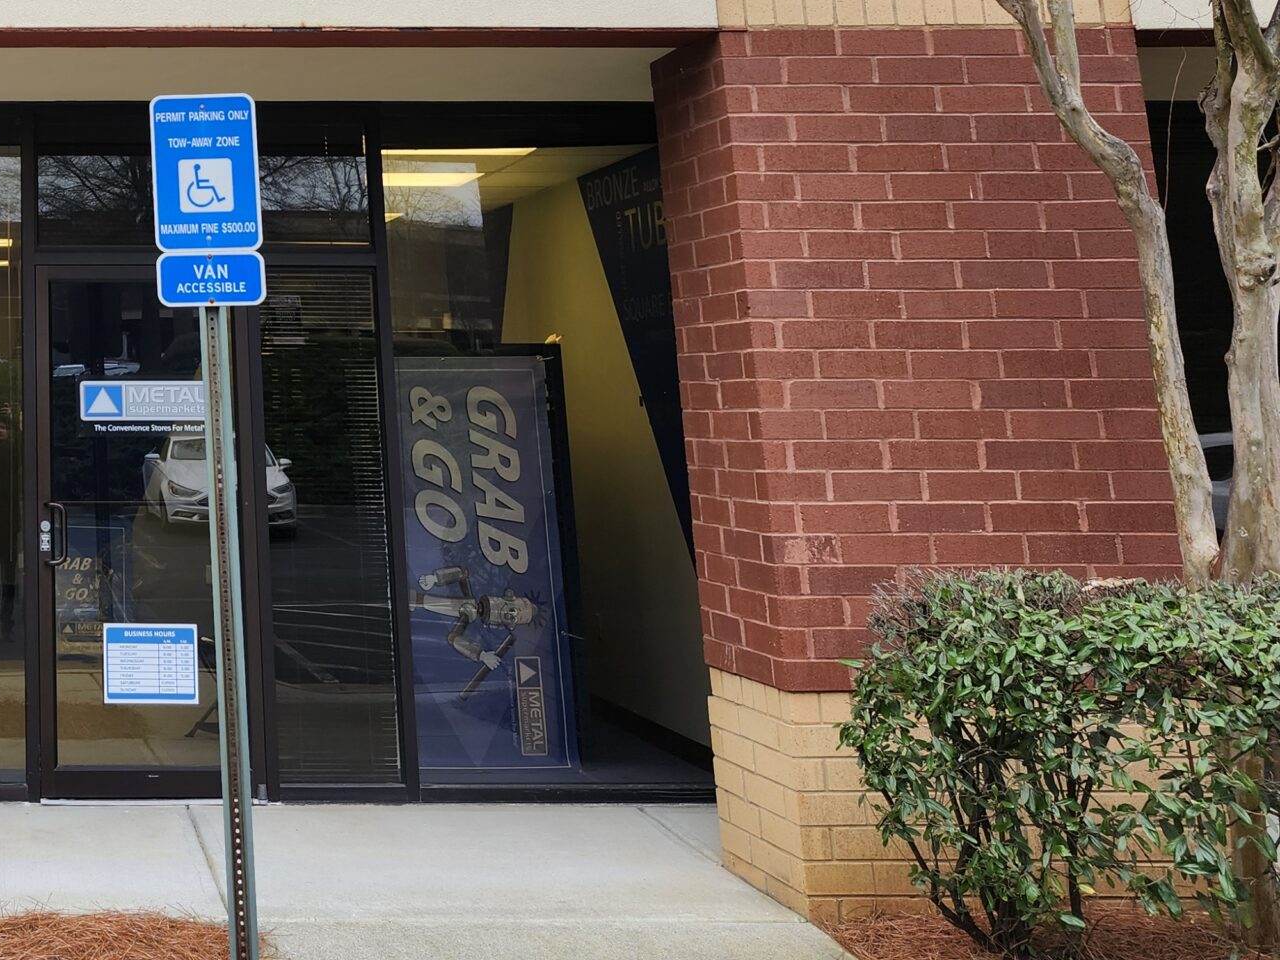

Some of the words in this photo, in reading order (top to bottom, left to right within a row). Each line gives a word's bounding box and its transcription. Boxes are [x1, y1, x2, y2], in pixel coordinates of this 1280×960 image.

[155, 111, 186, 123] PERMIT
[188, 110, 225, 122] PARKING
[227, 109, 250, 121] ONLY
[167, 136, 213, 148] TOW-AWAY
[216, 136, 241, 147] ZONE
[585, 165, 640, 211] BRONZE
[160, 223, 199, 235] MAXIMUM
[201, 223, 219, 234] FINE
[221, 221, 256, 233] $500.00
[624, 200, 668, 253] TUB
[193, 263, 229, 279] VAN
[176, 281, 247, 294] ACCESSIBLE
[129, 386, 204, 403] METAL
[408, 385, 453, 430] &
[94, 424, 107, 432] The
[107, 424, 150, 432] Convenience
[151, 424, 172, 432] Stores
[172, 424, 183, 432] For
[466, 384, 529, 575] GRAB
[411, 438, 468, 543] GO
[58, 556, 93, 571] RAB
[72, 573, 83, 585] &
[65, 587, 89, 600] GO
[154, 630, 176, 638] HOURS
[528, 691, 545, 751] METAL
